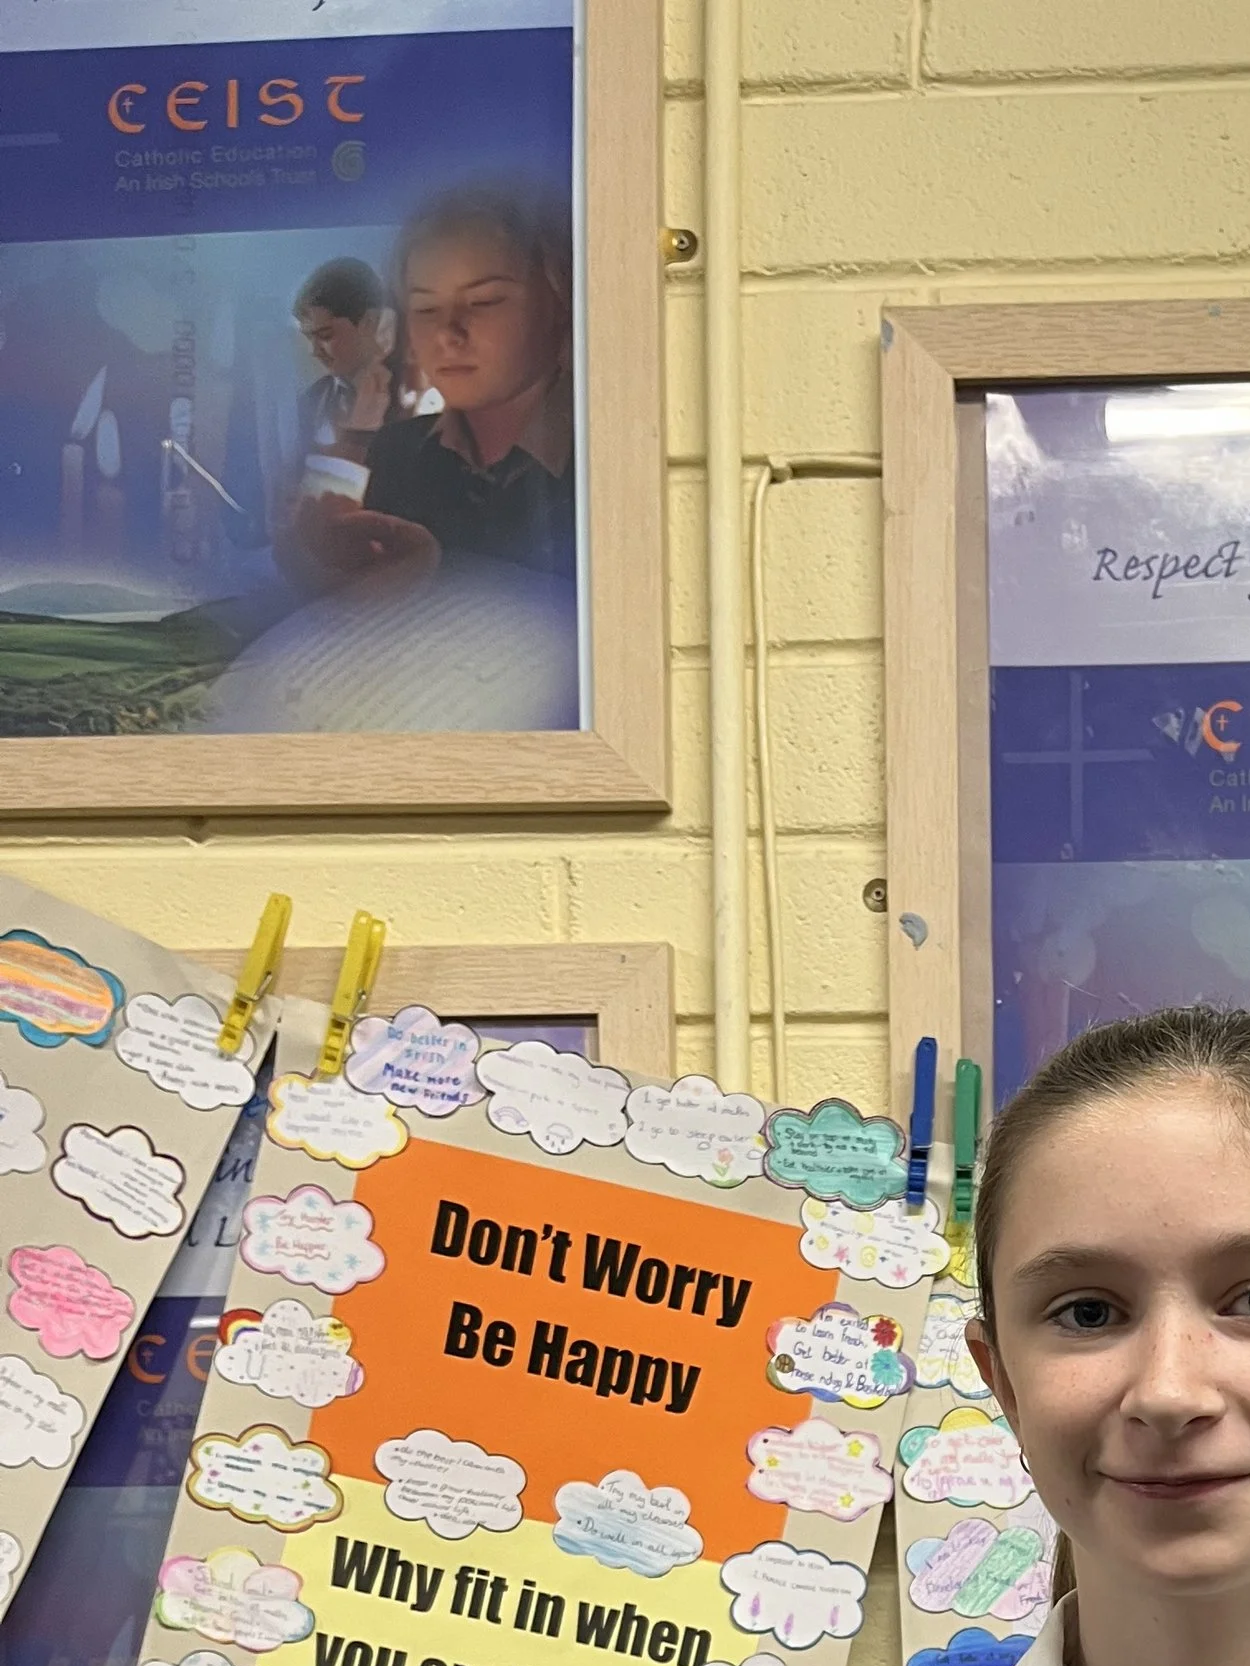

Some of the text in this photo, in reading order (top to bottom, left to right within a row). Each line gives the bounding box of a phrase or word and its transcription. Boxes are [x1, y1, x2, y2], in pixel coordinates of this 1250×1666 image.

[107, 75, 366, 134] CEIST
[114, 143, 318, 169] Catholic Education
[114, 171, 141, 193] An
[1092, 540, 1242, 599] Respect
[1208, 793, 1236, 814] An
[430, 1198, 754, 1329] Don't Worry
[443, 1300, 703, 1415] Be Happy
[330, 1535, 446, 1614] Why
[450, 1564, 510, 1625] fit
[513, 1578, 567, 1638] in
